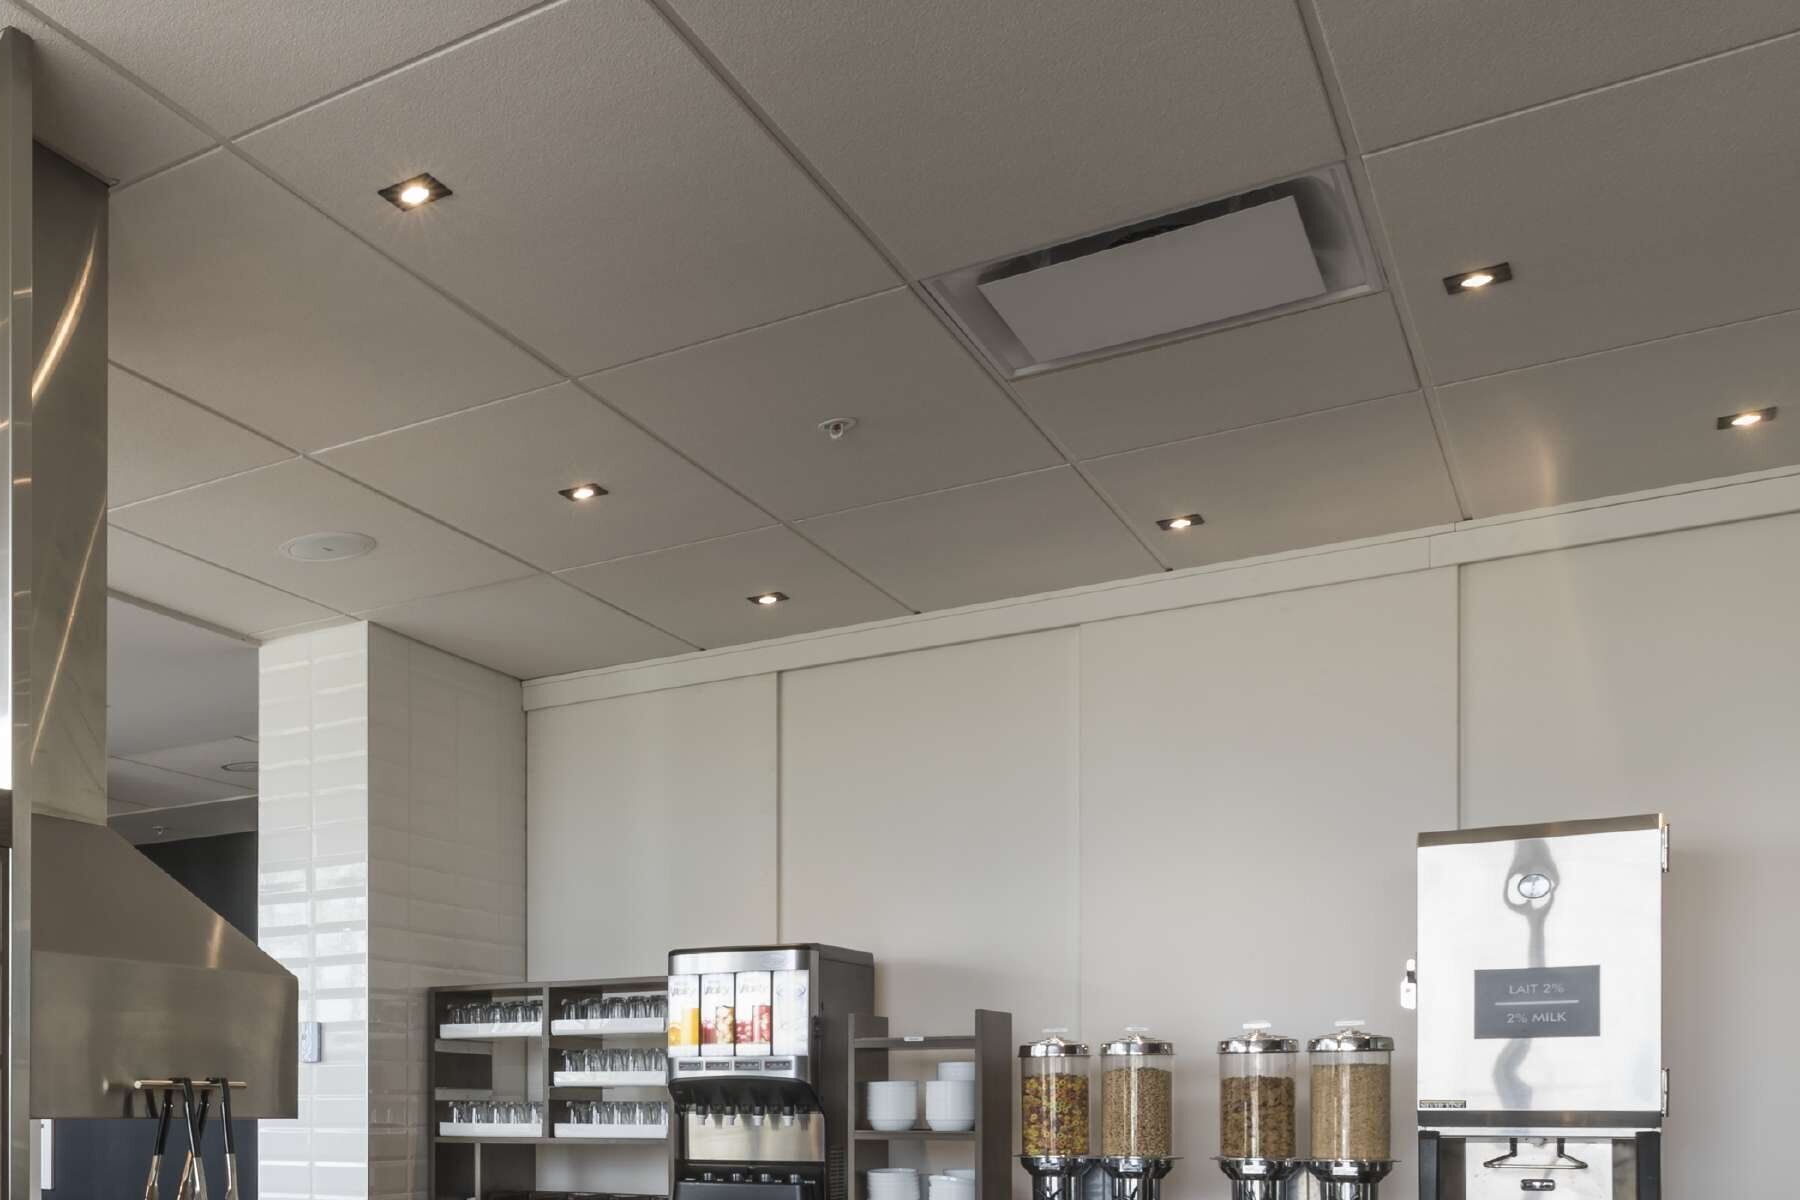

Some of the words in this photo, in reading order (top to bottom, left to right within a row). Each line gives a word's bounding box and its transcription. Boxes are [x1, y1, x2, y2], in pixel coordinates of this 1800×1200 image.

[1508, 983, 1538, 995] LAIT
[1543, 983, 1565, 994] 2%
[1506, 1013, 1528, 1024] 2%
[1531, 1011, 1567, 1023] MILK
